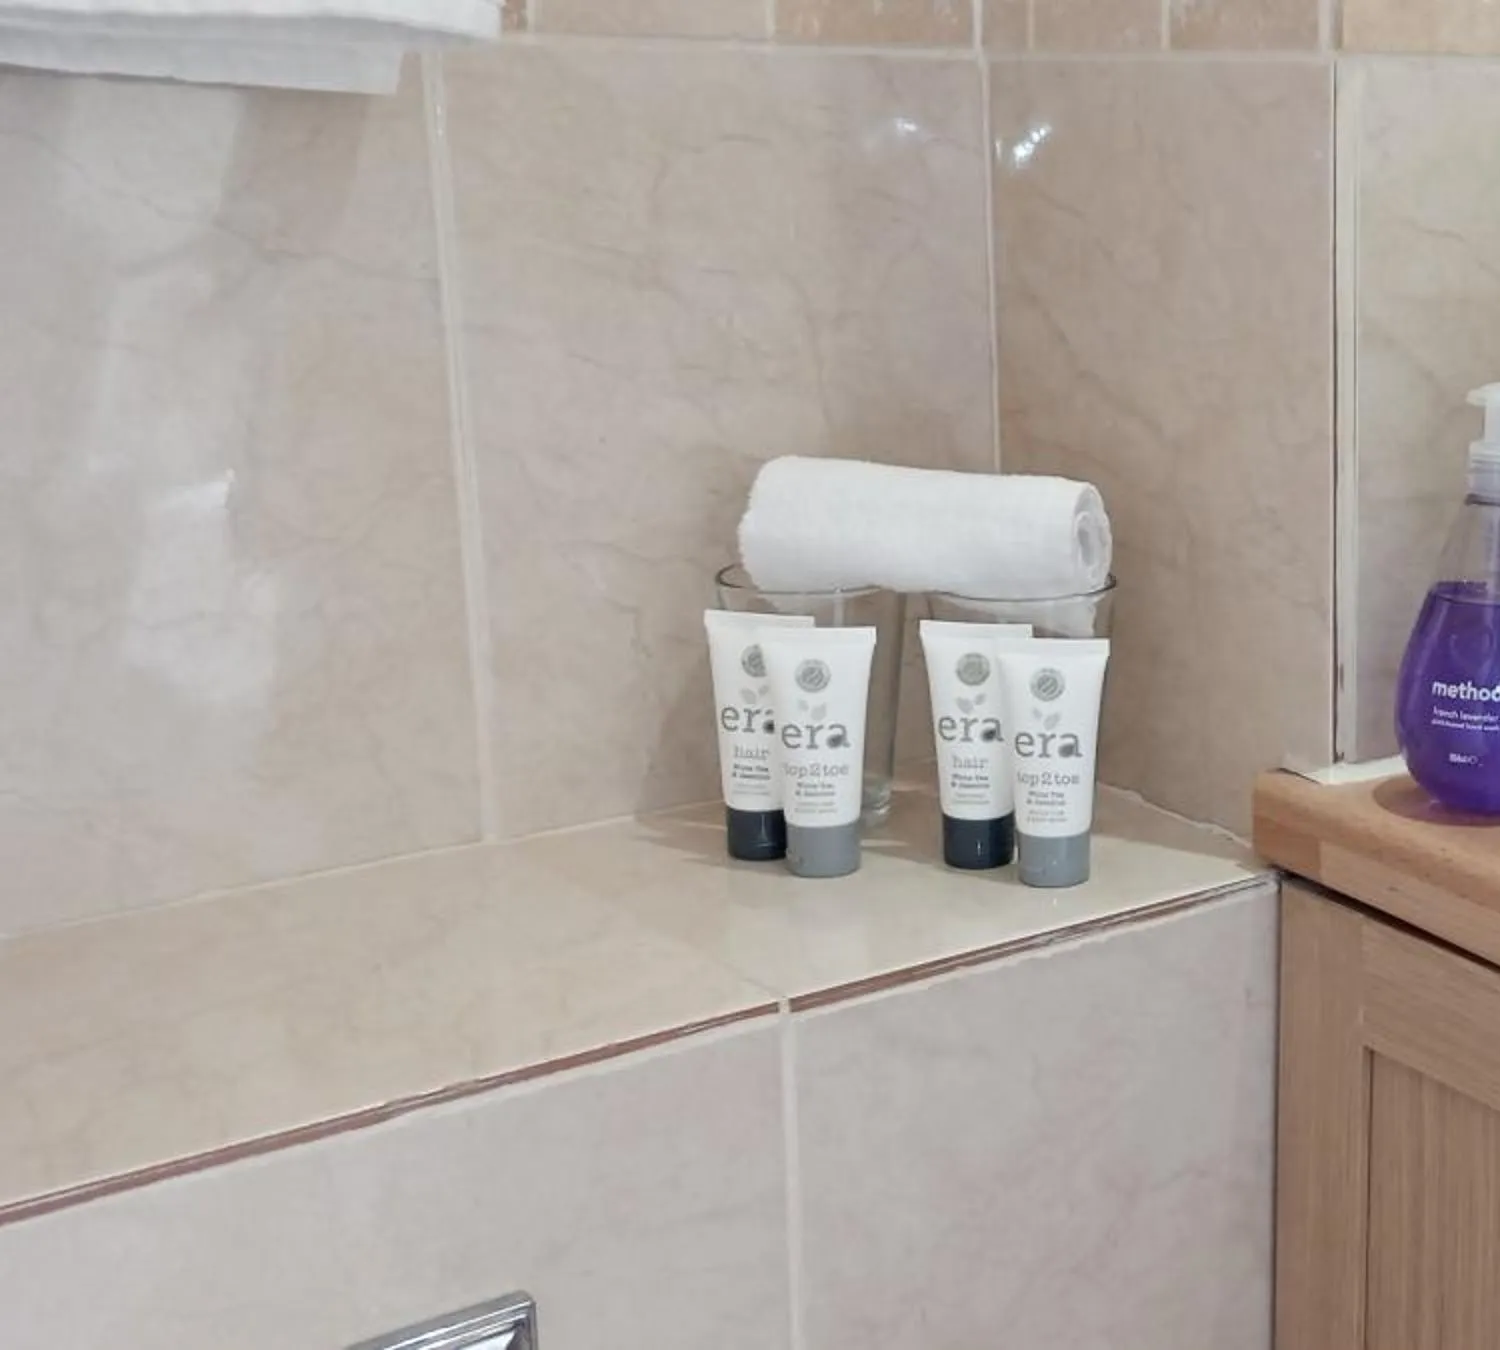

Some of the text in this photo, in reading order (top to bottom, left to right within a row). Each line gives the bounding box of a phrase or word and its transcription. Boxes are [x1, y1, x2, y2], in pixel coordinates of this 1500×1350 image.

[781, 722, 852, 750] era
[937, 715, 1005, 743] era
[1014, 730, 1084, 758] era
